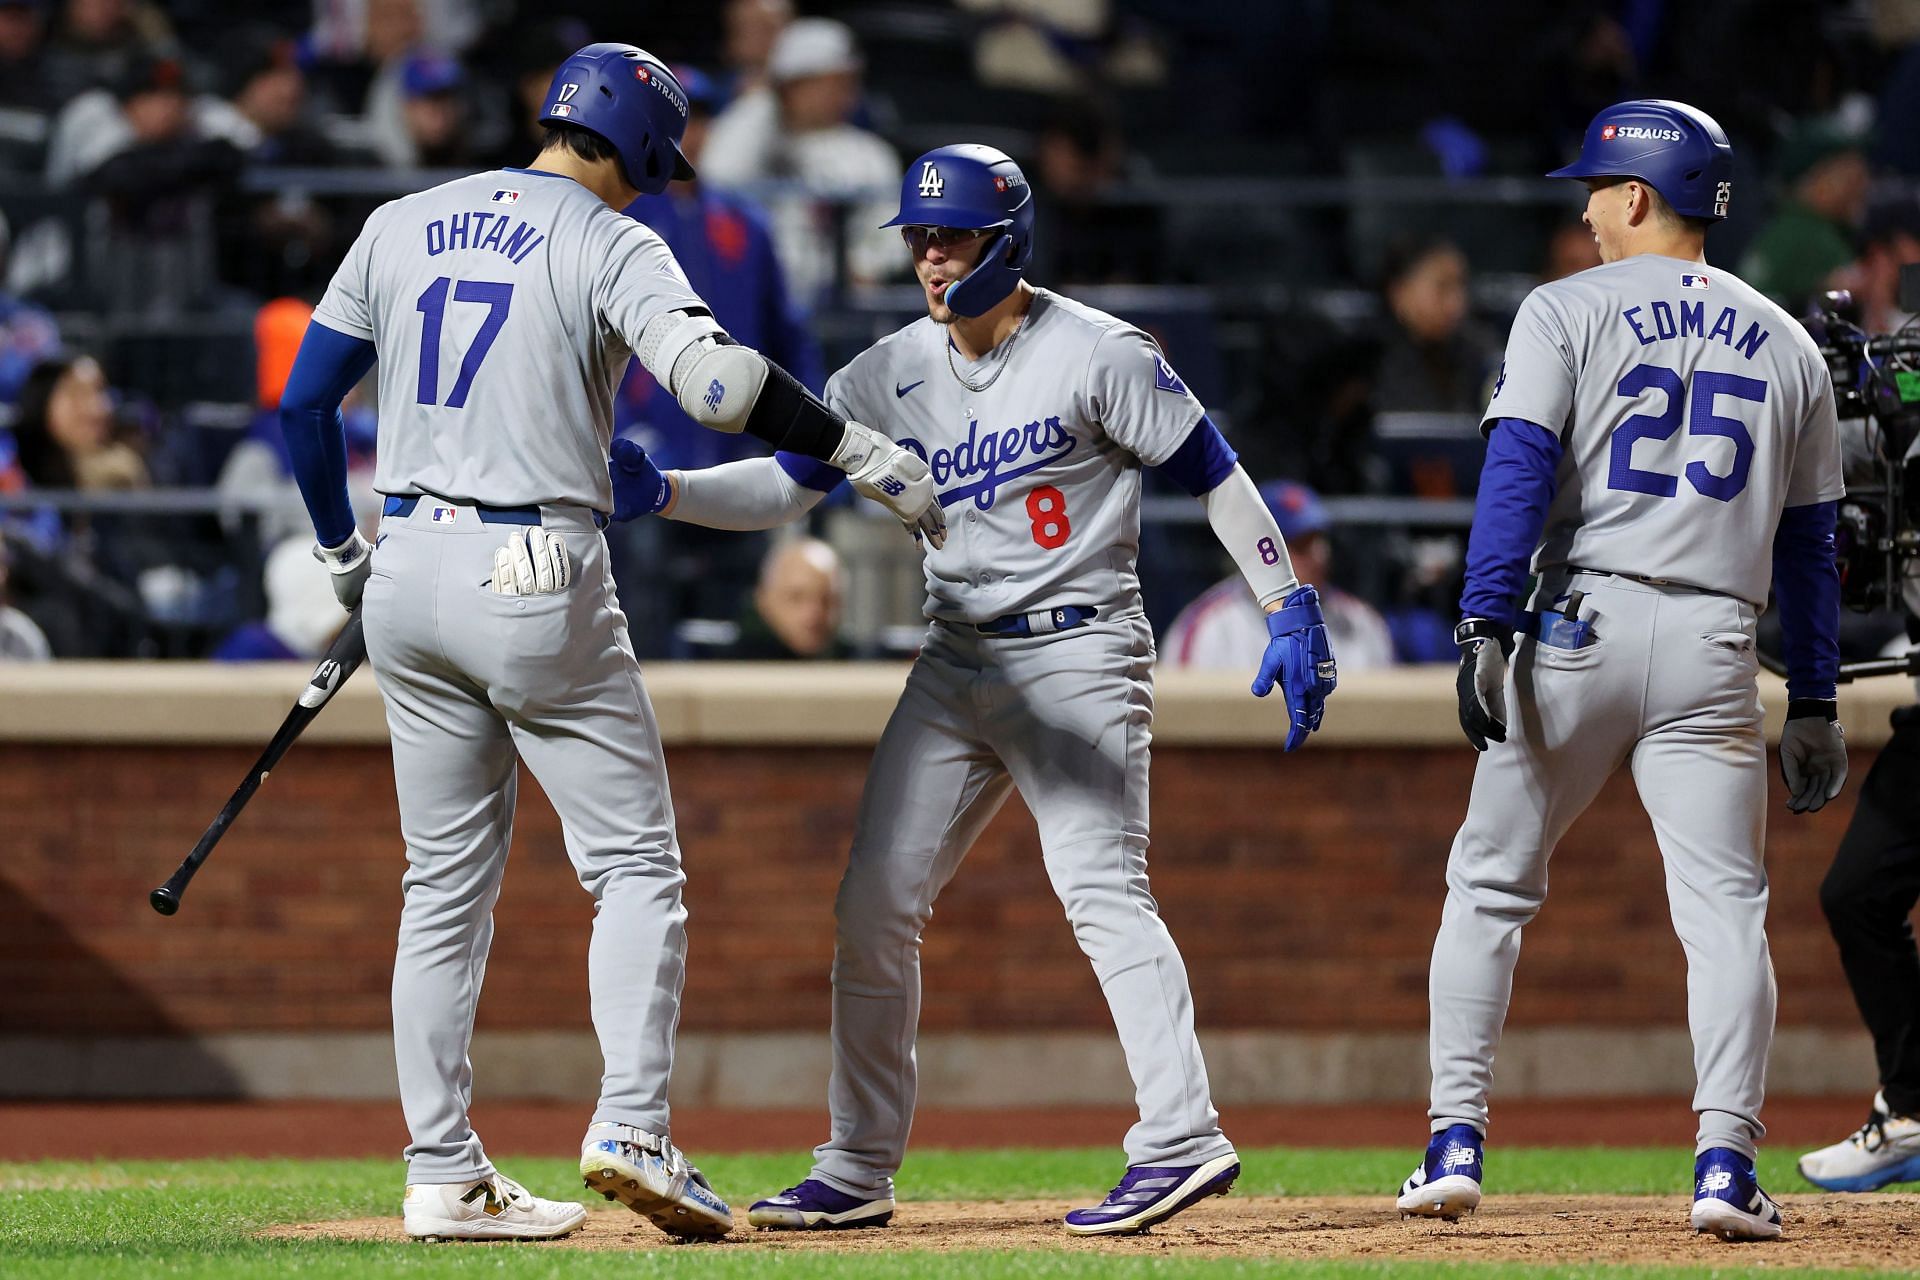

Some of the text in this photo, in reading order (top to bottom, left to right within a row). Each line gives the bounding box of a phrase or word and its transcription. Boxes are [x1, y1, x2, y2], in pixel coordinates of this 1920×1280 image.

[558, 83, 578, 102] 17
[651, 77, 687, 117] STRAUSS
[1618, 127, 1680, 141] STRAUSS
[918, 161, 945, 198] LA
[1716, 181, 1732, 202] 25
[426, 212, 545, 265] OHTANI
[416, 276, 515, 408] 17
[1622, 300, 1770, 361] EDMAN
[1607, 363, 1768, 503] 25
[1025, 484, 1071, 550] 8
[1256, 536, 1280, 566] 8
[1056, 610, 1066, 623] 8
